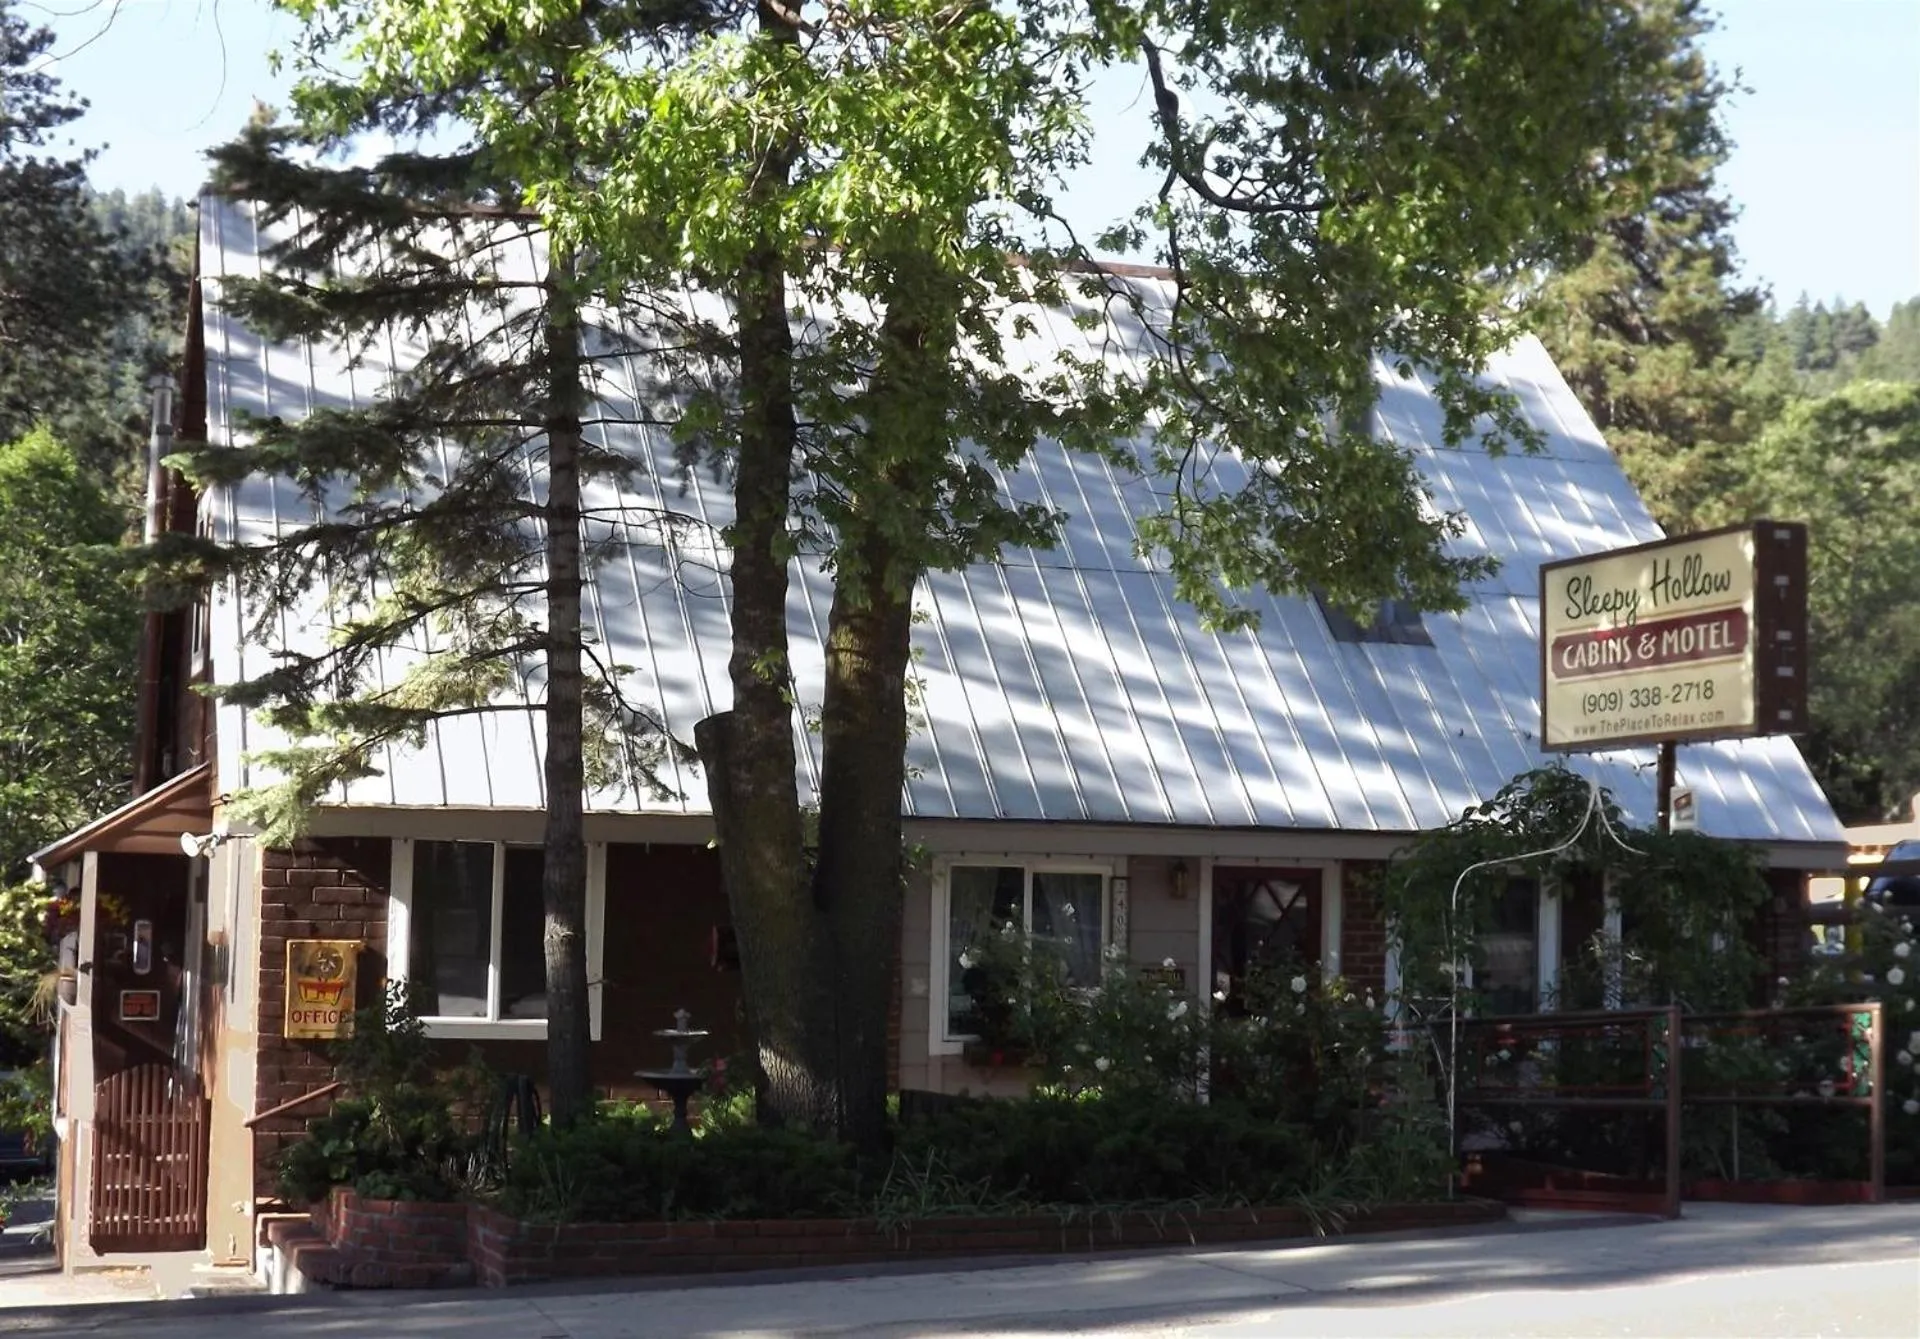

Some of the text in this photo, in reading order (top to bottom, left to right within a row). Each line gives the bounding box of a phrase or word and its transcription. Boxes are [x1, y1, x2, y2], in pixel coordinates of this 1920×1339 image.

[1565, 552, 1732, 627] Sleepy Hollow
[1562, 620, 1736, 670] CABINS & MOTEL
[1582, 679, 1715, 717] (909) 338-2718
[1573, 709, 1725, 737] www.ThePlaceToRelax.com
[291, 1009, 350, 1025] OFFICE
